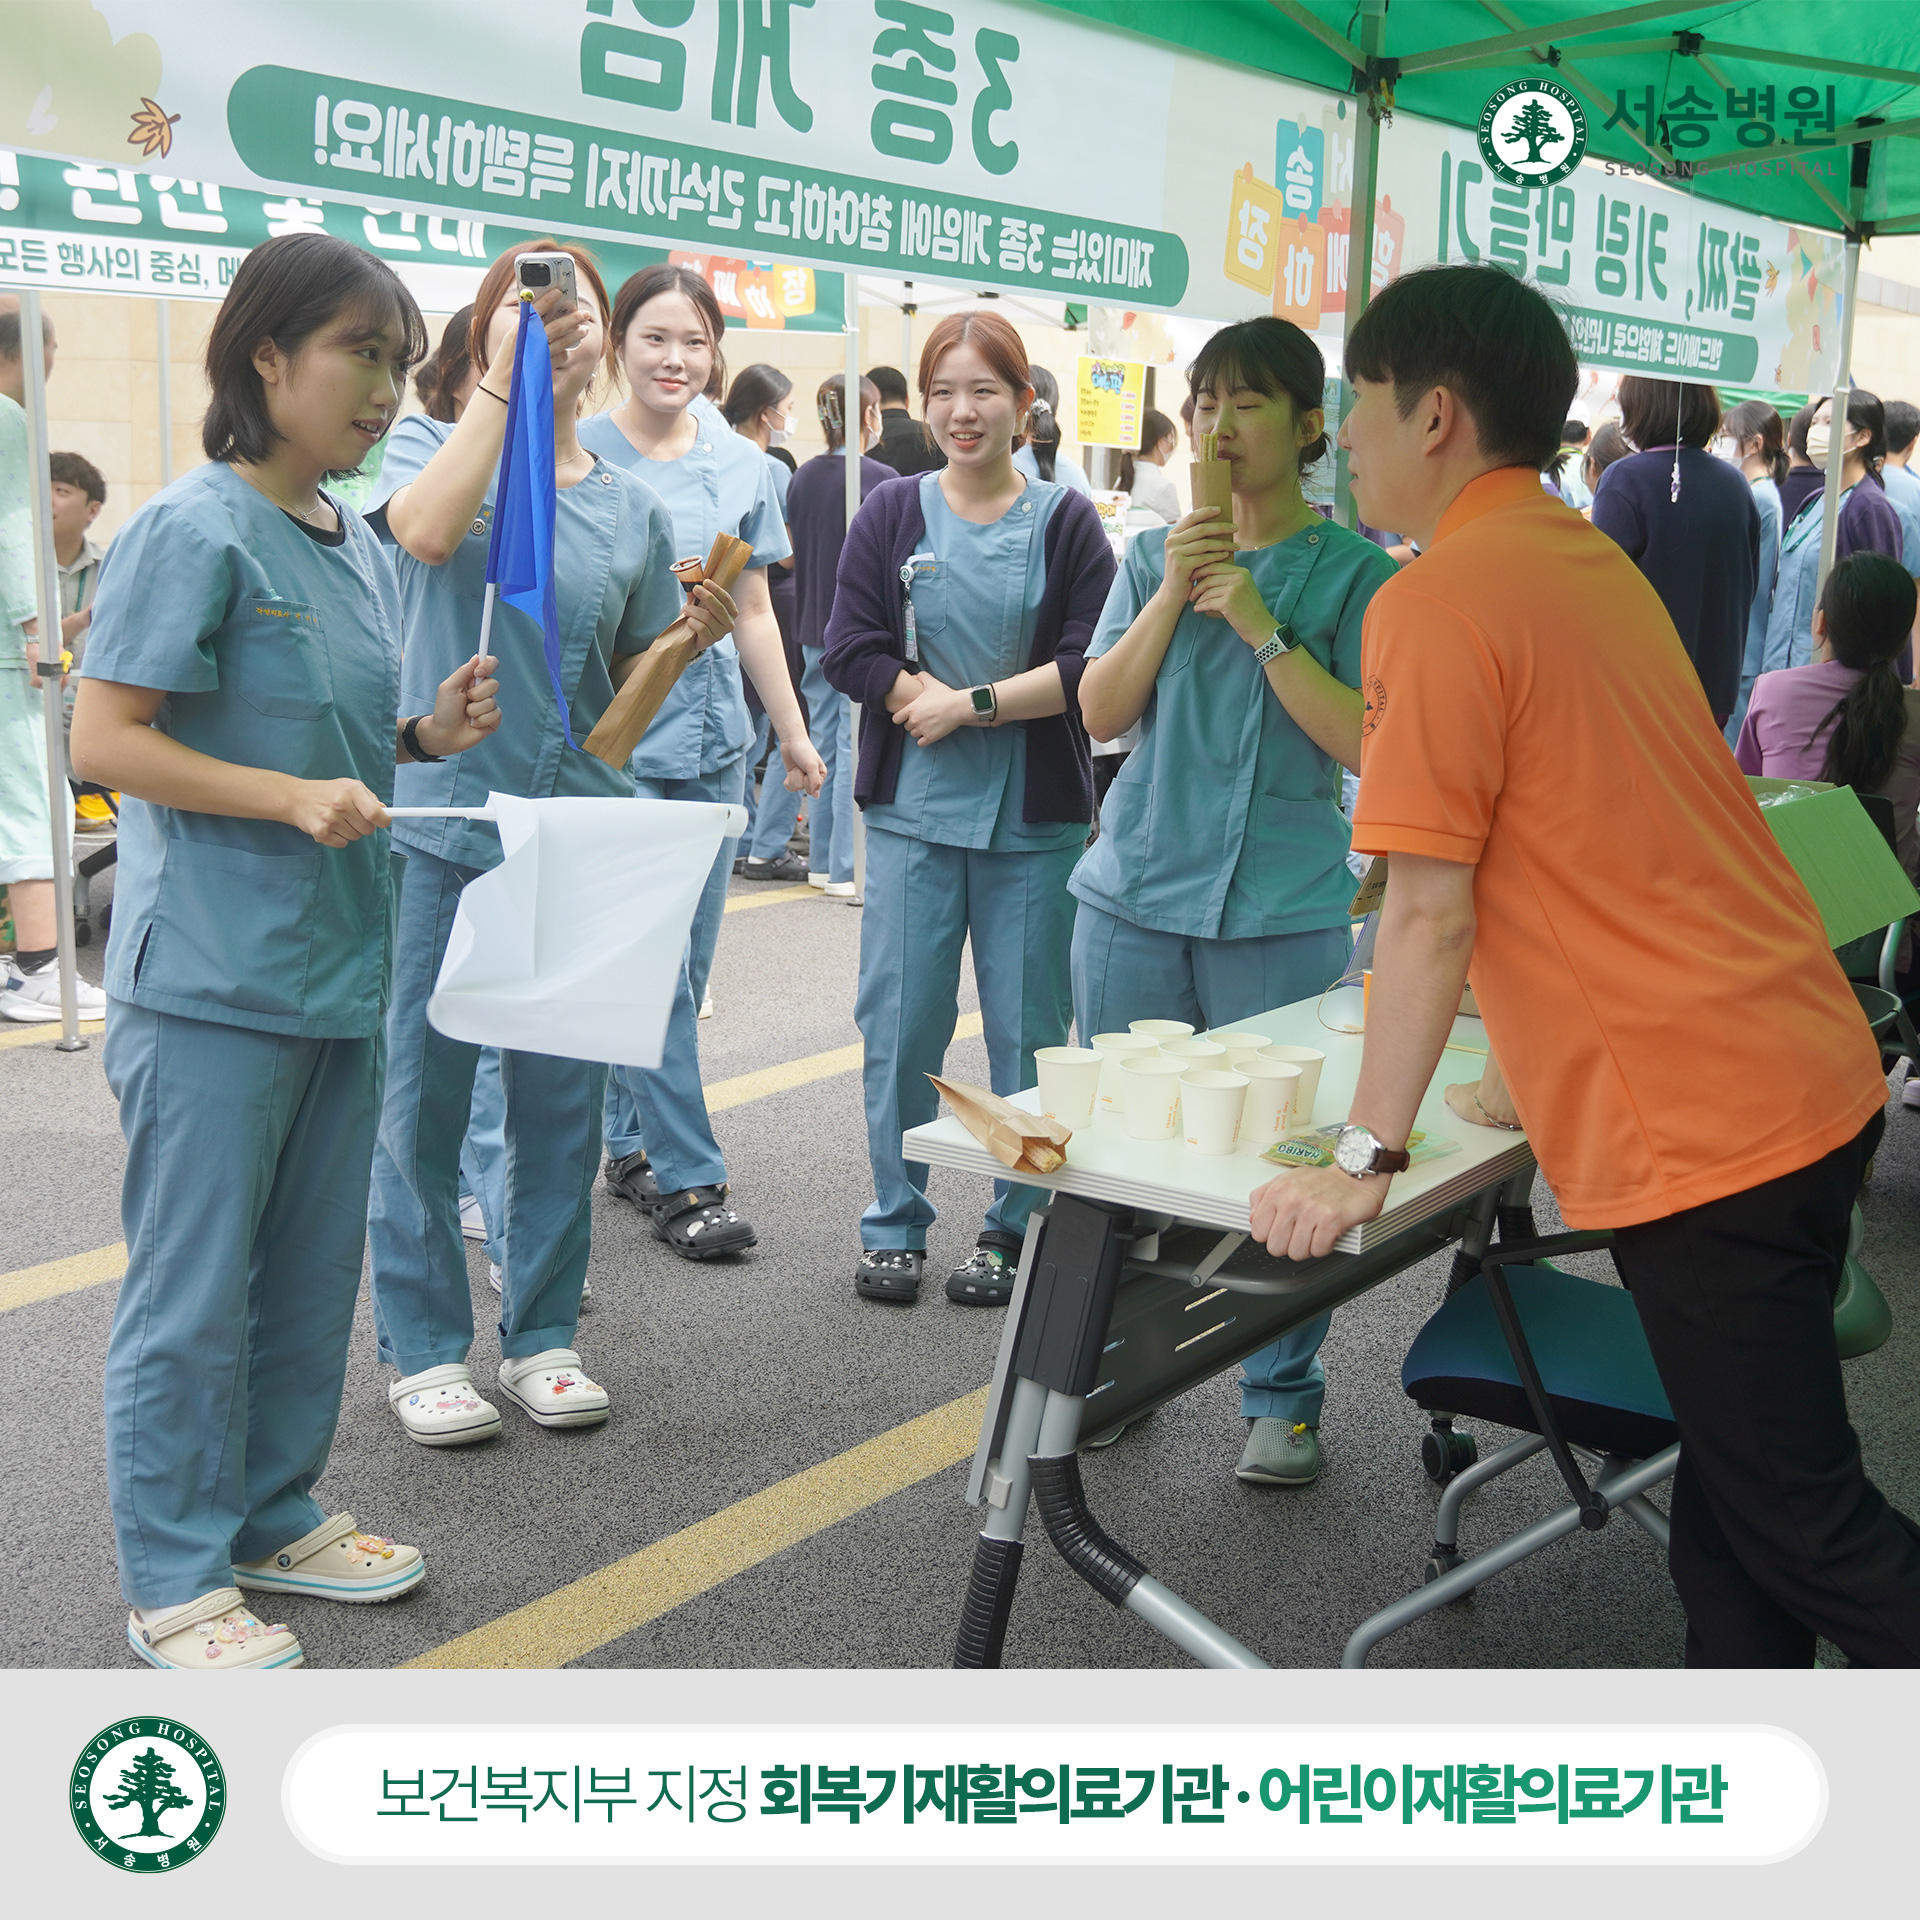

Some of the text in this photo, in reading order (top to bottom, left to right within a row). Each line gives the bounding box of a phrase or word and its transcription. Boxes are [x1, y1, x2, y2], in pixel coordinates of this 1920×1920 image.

[0, 237, 48, 274] 모든
[57, 241, 141, 281] 행사의
[150, 250, 209, 290] 중심,
[1277, 1144, 1321, 1160] HARIBO
